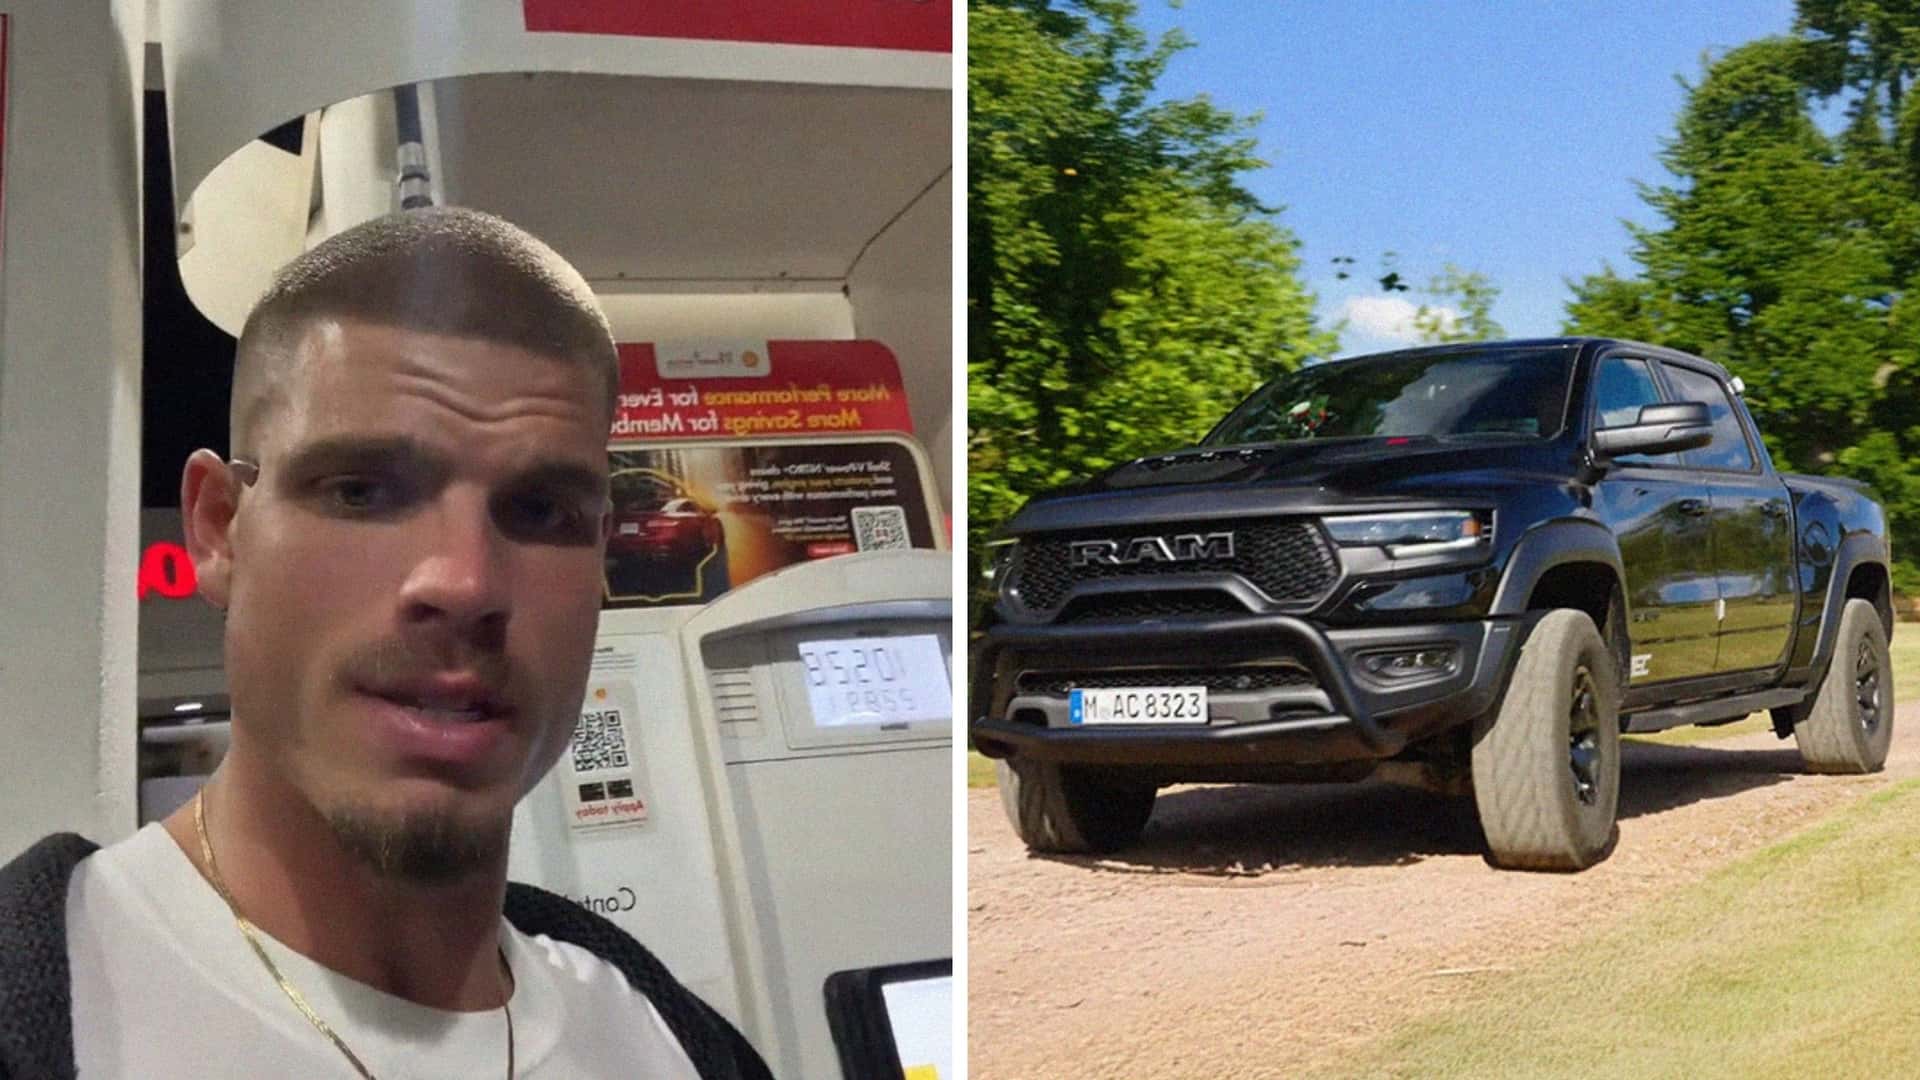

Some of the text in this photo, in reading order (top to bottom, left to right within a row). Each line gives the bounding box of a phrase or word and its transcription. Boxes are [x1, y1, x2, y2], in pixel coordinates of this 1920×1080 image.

[1070, 531, 1235, 567] RAM
[1084, 692, 1200, 719] M AC 8323
